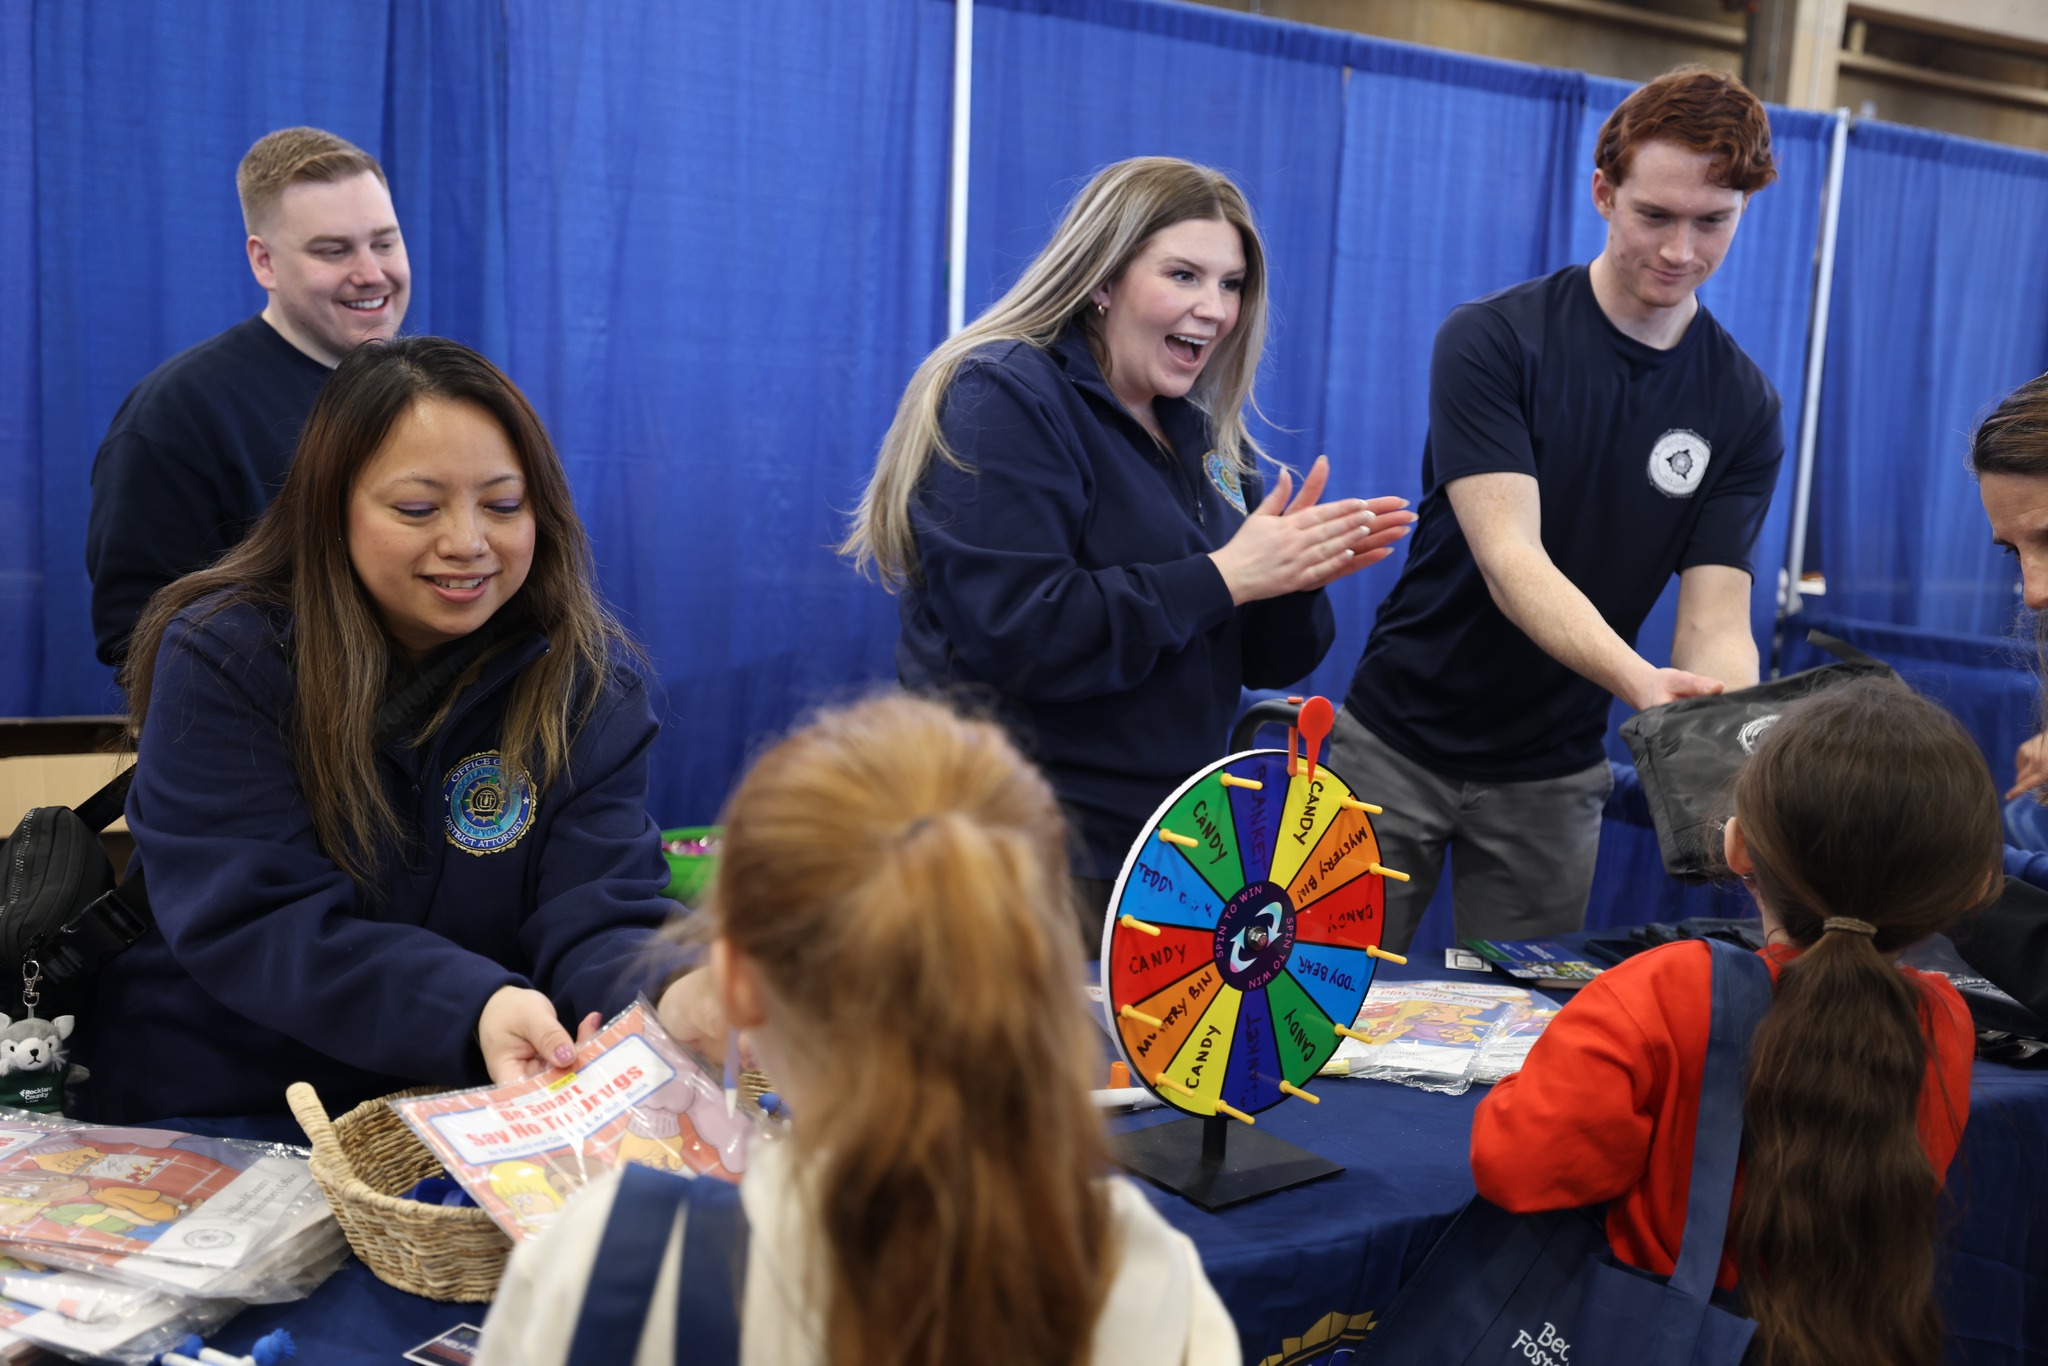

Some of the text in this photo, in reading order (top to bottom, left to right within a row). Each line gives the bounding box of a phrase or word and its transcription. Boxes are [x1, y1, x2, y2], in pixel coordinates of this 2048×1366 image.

[451, 757, 491, 782] OFFICE
[444, 815, 476, 847] DISTRICT
[1293, 780, 1324, 846] CANDY
[477, 818, 525, 848] ATTORNEY
[1193, 800, 1228, 865] CANDY
[1320, 826, 1368, 881] MYSTERY
[1215, 885, 1263, 958] SPIN TO WIN
[1129, 944, 1186, 975] CANDY
[1248, 917, 1294, 990] SPIN TO WIN
[1188, 971, 1214, 1000] BIN
[1284, 1008, 1316, 1063] CANDY
[1185, 1025, 1222, 1089] CANDY
[25, 1092, 49, 1100] County
[499, 1109, 526, 1122] Be
[525, 1084, 585, 1117] Smart
[465, 1129, 511, 1147] Say
[509, 1122, 543, 1139] No
